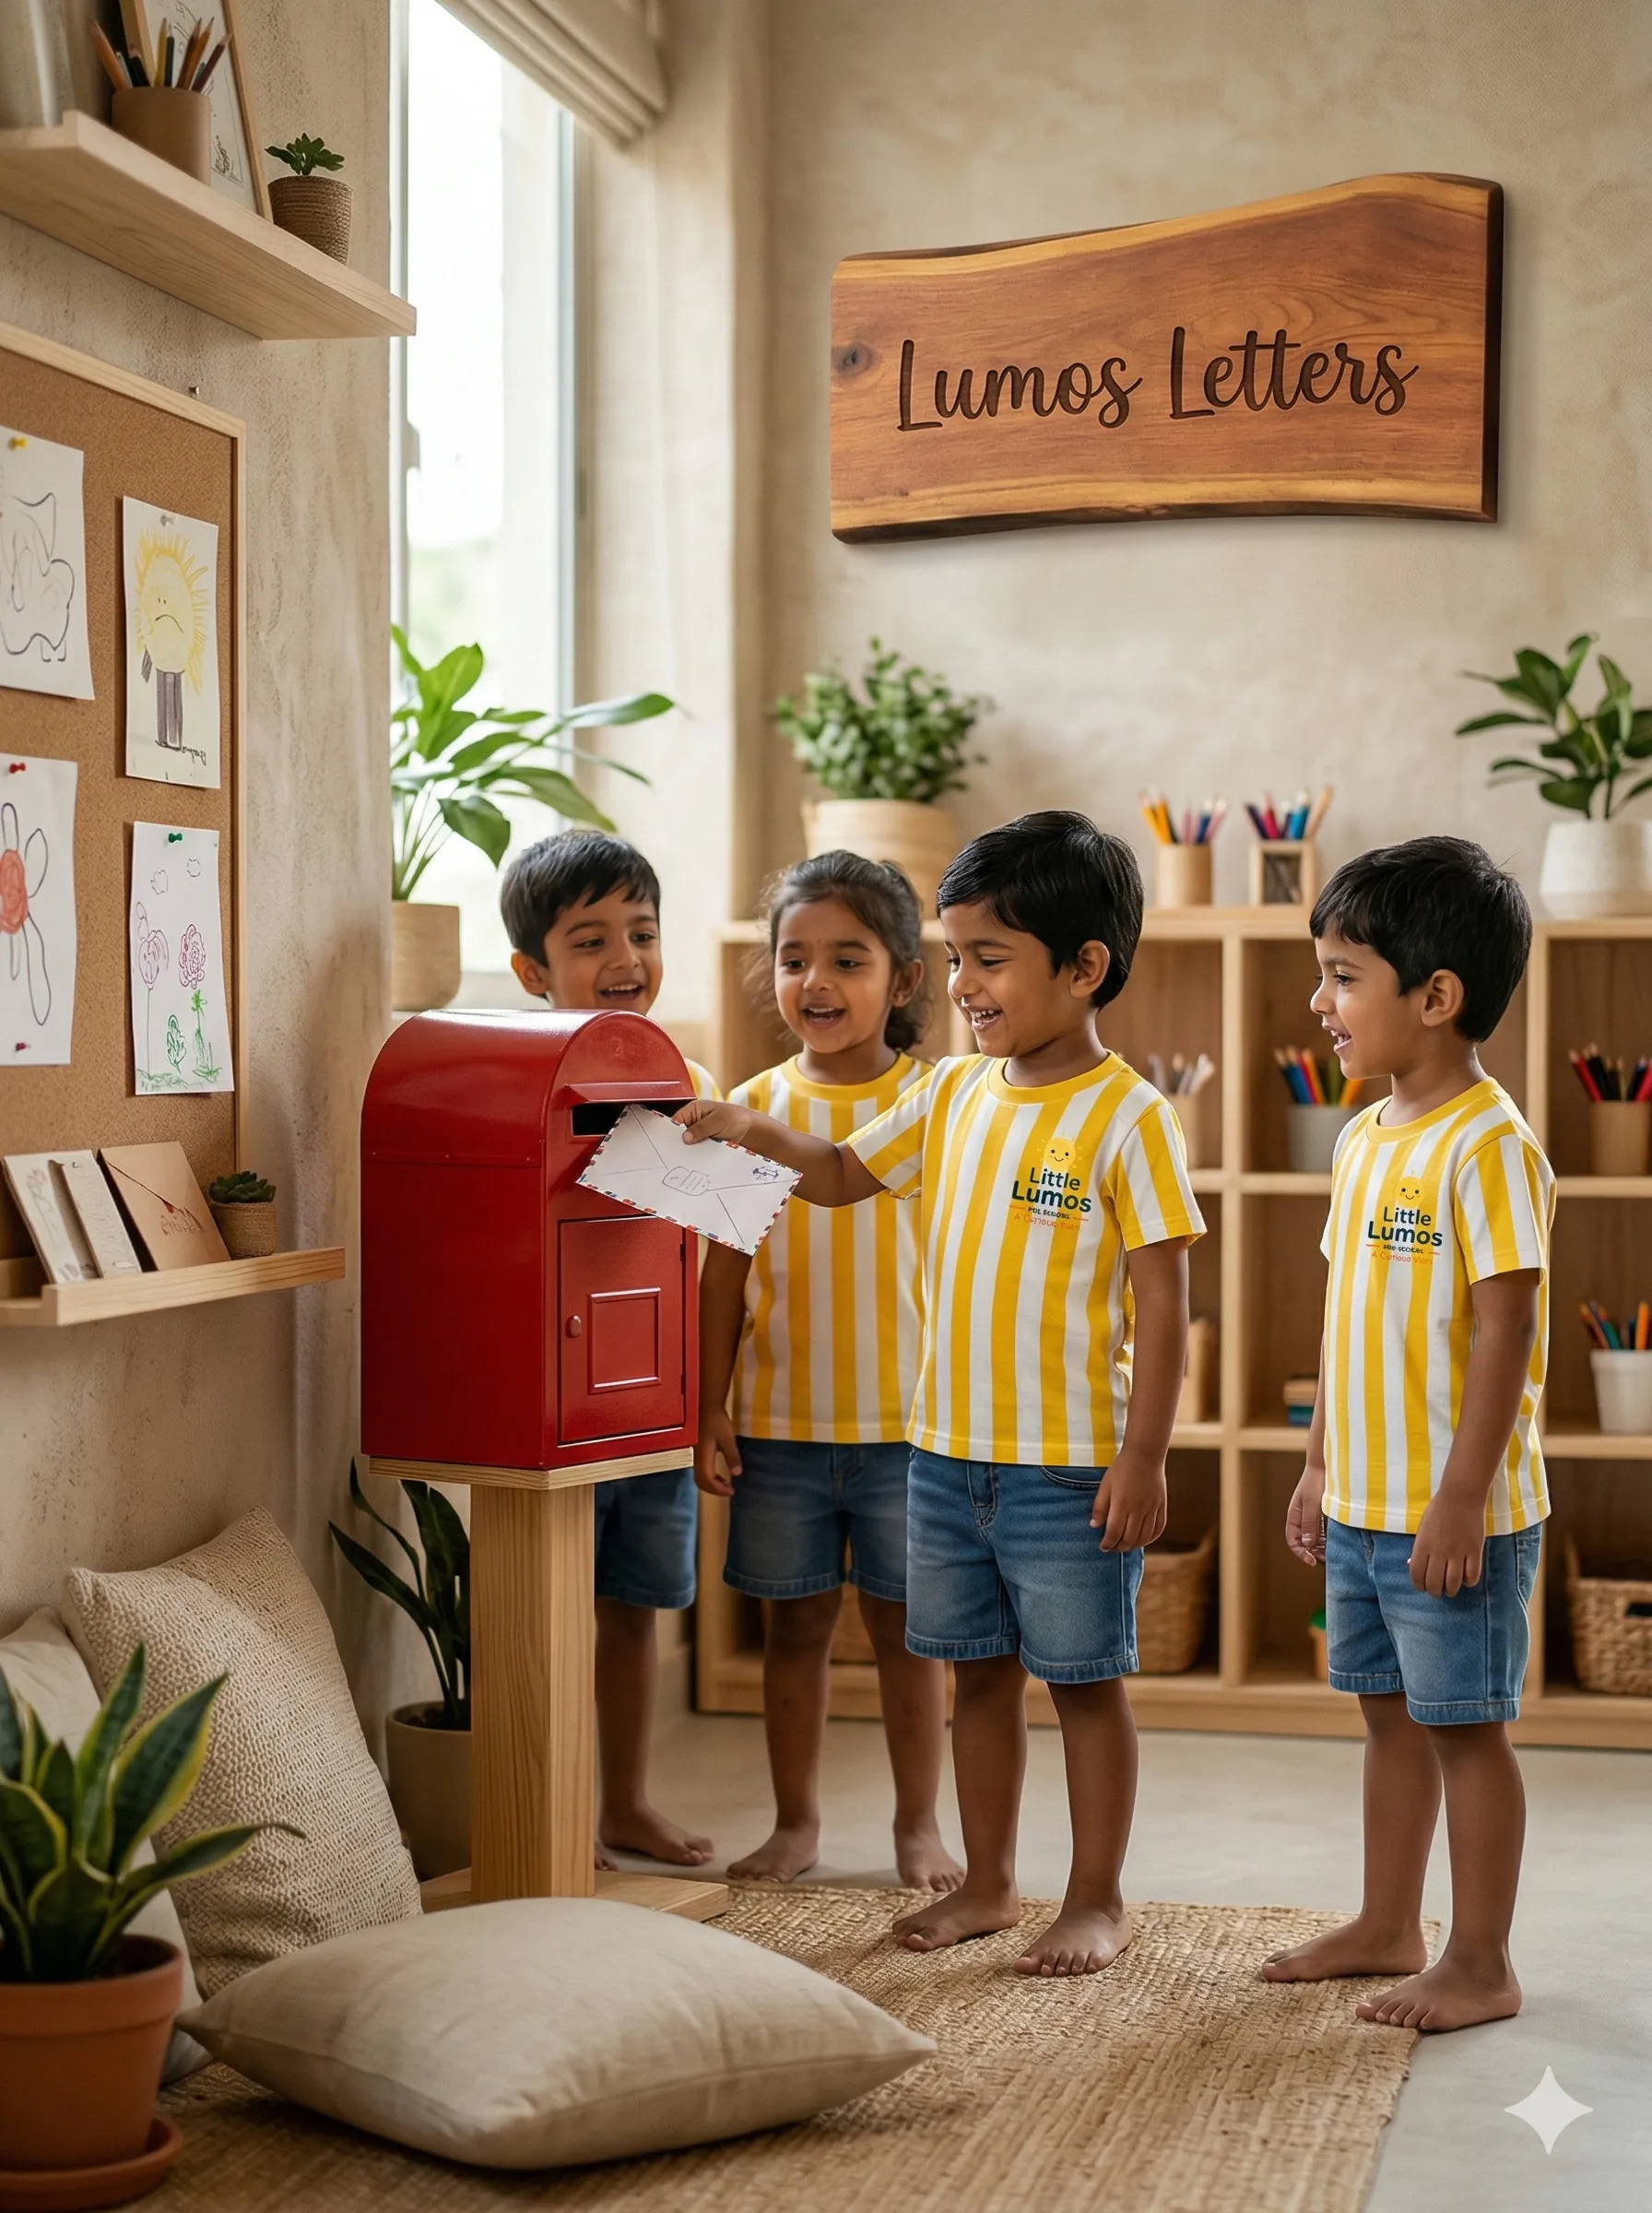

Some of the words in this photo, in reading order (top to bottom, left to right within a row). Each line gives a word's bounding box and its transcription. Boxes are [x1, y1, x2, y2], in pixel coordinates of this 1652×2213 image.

[897, 339, 1143, 432] Lumos
[1169, 325, 1420, 420] Letters
[1029, 1166, 1081, 1191] Little
[1011, 1180, 1092, 1213] Lumos
[1383, 1206, 1432, 1226] Little
[1367, 1220, 1444, 1247] Lumos
